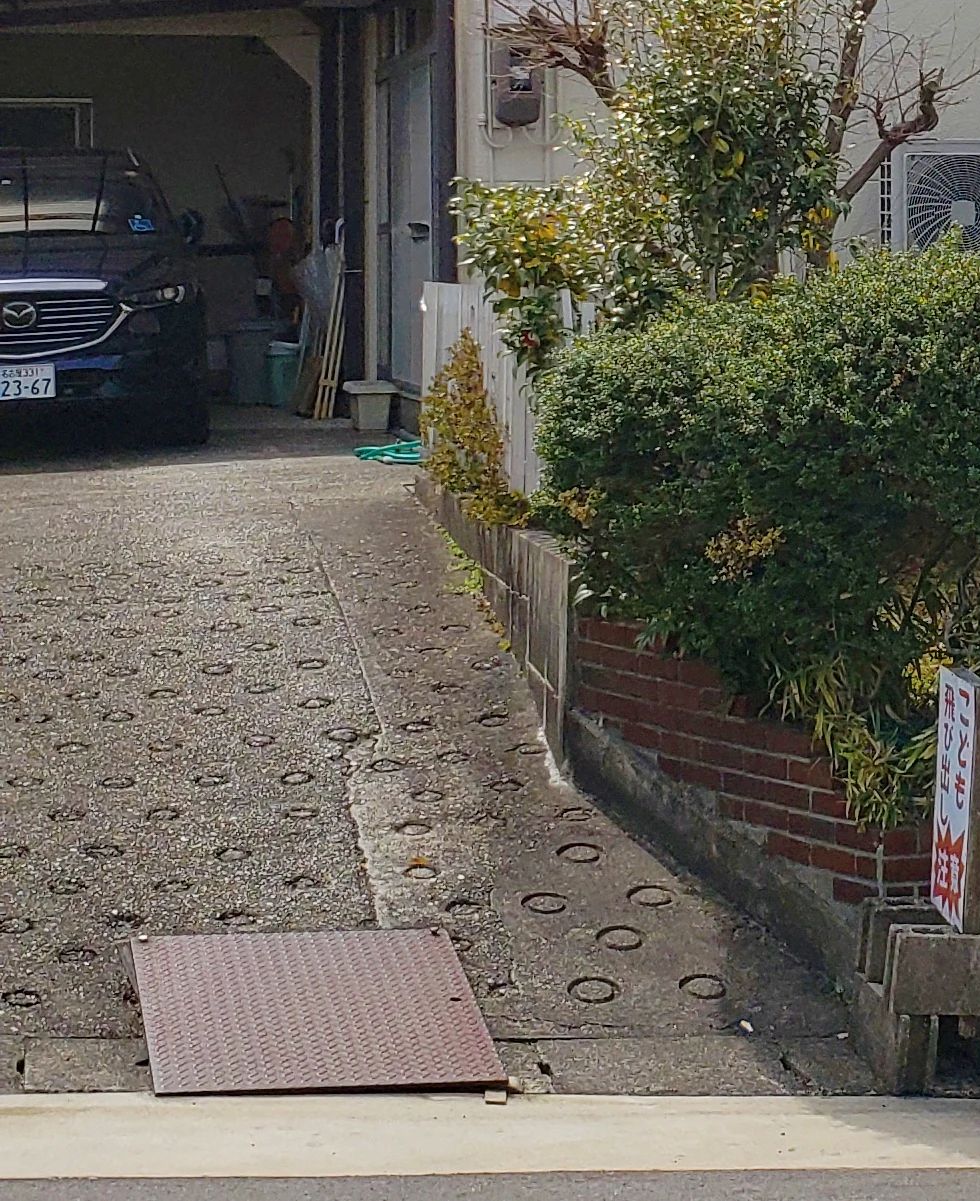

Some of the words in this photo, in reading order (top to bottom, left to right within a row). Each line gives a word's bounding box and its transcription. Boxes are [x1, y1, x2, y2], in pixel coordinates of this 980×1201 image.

[1, 378, 51, 397] 23-67
[940, 683, 955, 826] 飛び出し
[954, 687, 970, 810] こども
